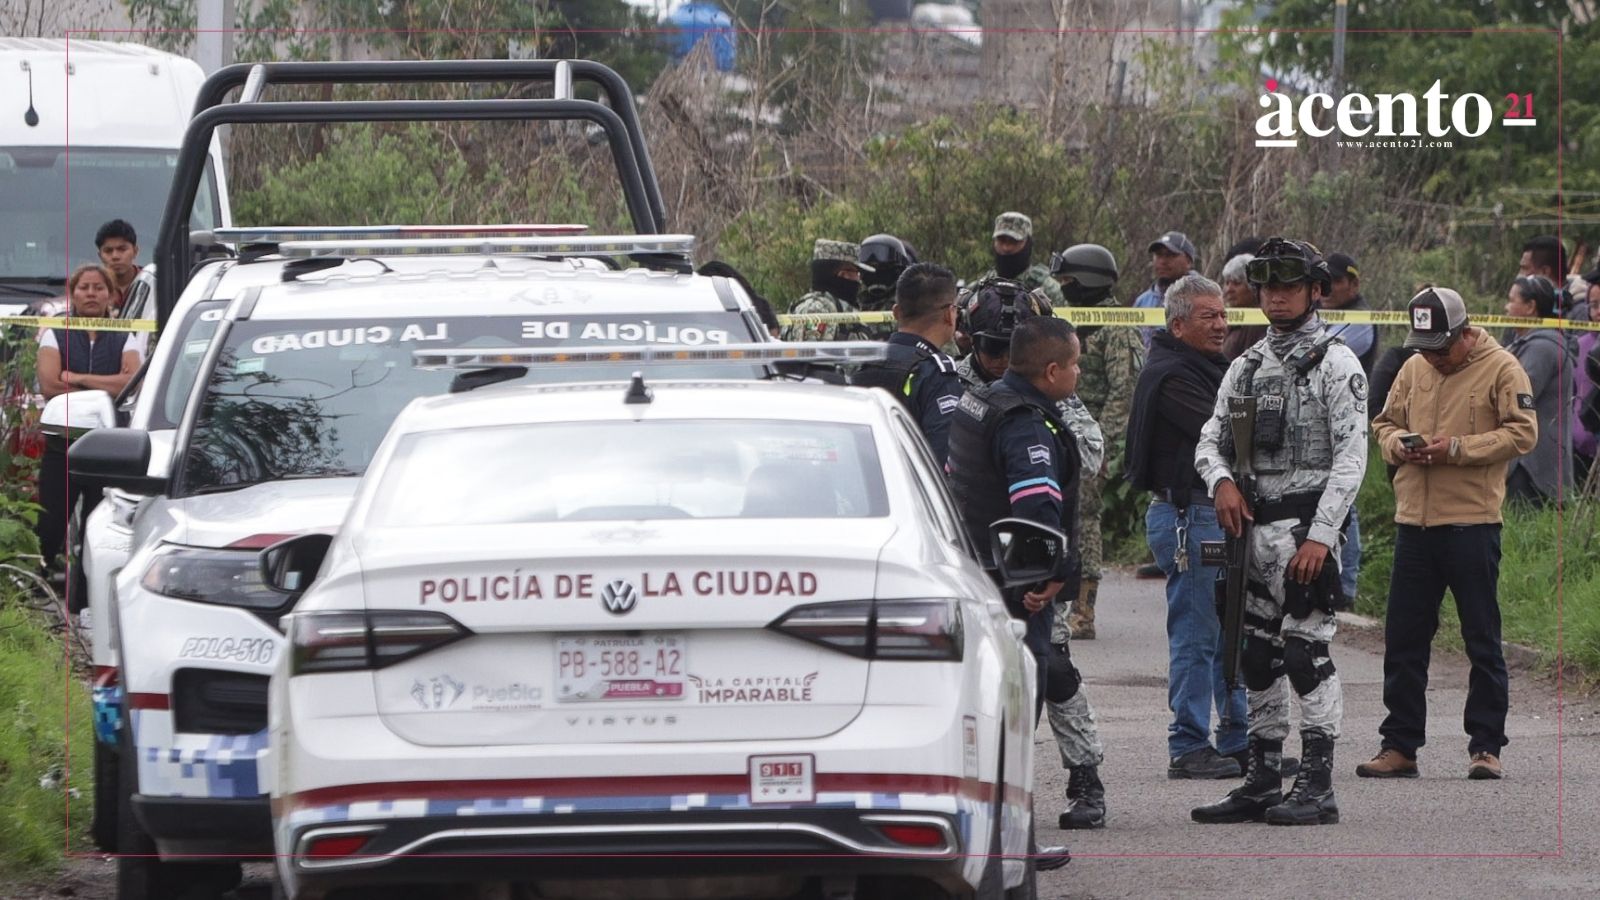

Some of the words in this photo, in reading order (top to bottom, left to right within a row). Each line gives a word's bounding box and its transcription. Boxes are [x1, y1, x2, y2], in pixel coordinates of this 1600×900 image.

[420, 569, 543, 605] POLICÍA
[555, 574, 593, 599] DE
[641, 572, 683, 596] LA
[693, 571, 818, 596] CIUDAD
[179, 637, 274, 664] PDLC-516
[559, 648, 681, 678] PB-588-A2
[610, 683, 650, 692] PUEBLA
[705, 679, 723, 688] LA
[732, 678, 801, 687] CAPITAL
[762, 764, 801, 776] 911
